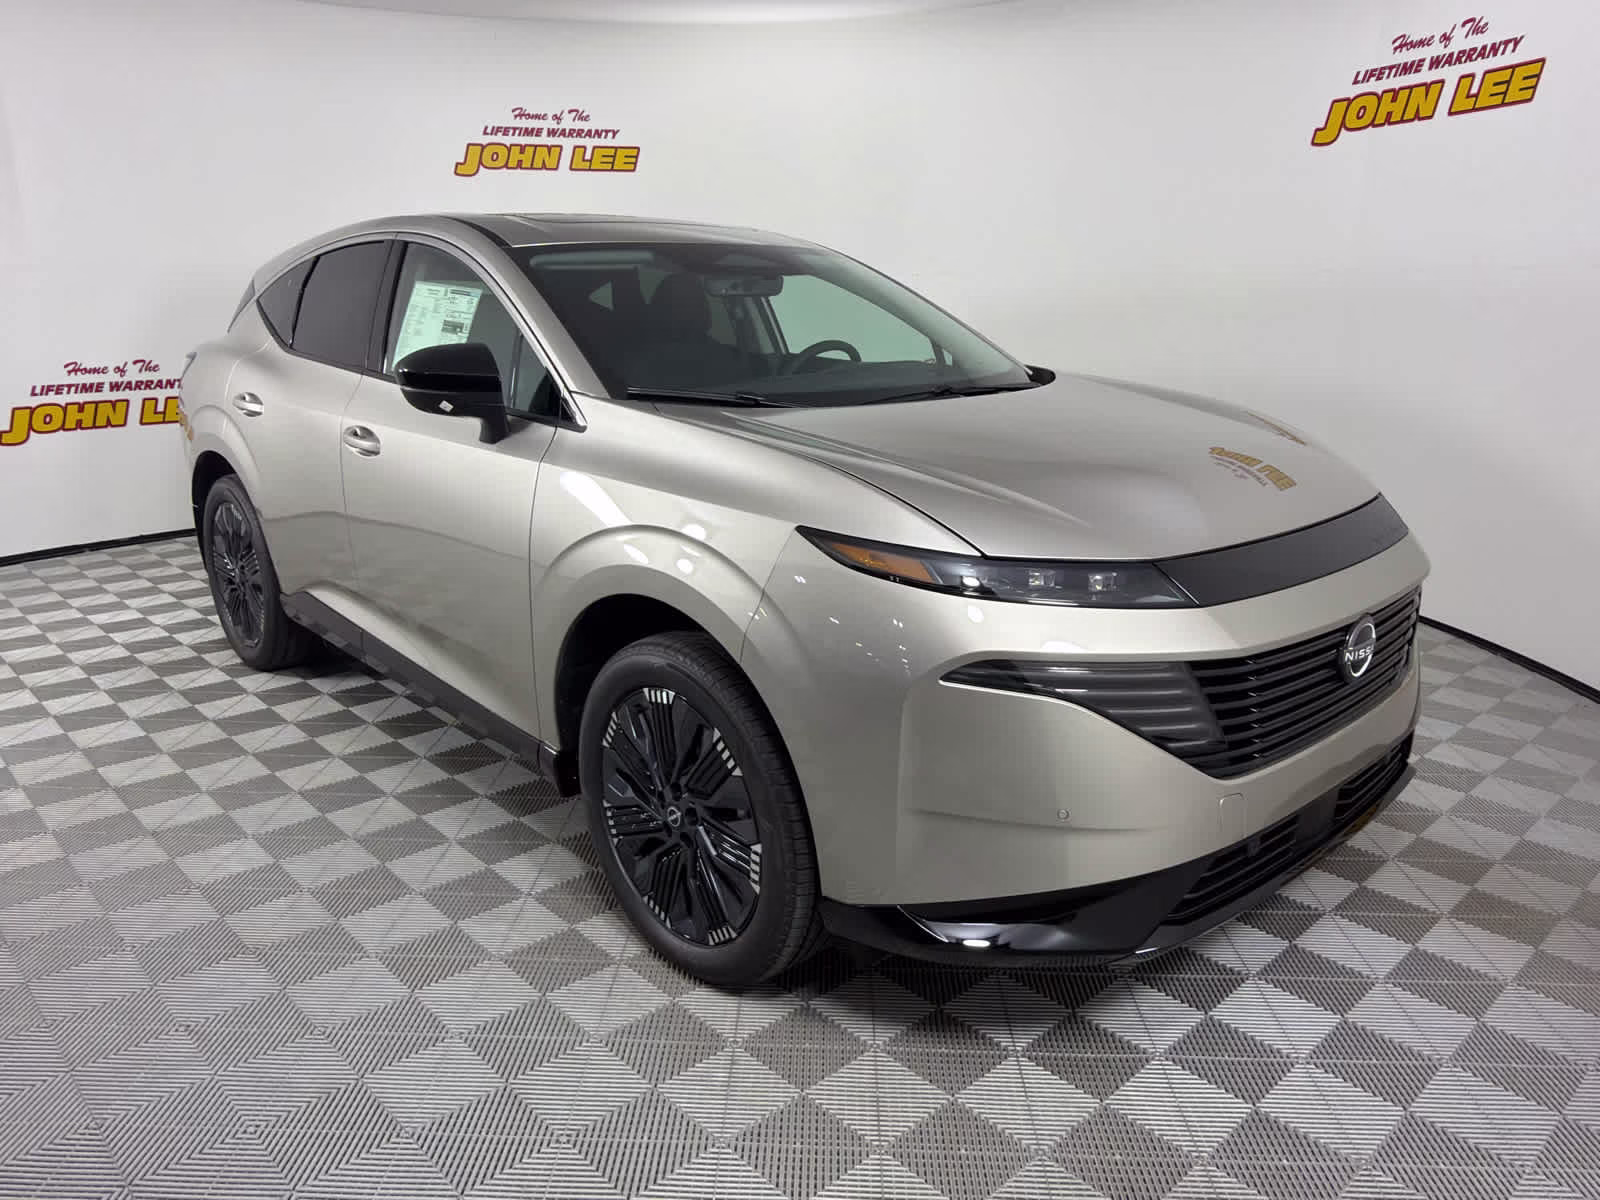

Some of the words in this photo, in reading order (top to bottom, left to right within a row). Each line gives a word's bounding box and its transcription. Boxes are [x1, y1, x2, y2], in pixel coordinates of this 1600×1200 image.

[1391, 33, 1435, 55] Home
[1438, 24, 1456, 49] of
[1461, 16, 1489, 39] The
[1352, 58, 1425, 86] LIFETIME
[1428, 35, 1525, 72] WARRANTY
[1310, 79, 1446, 147] JOHN
[1447, 57, 1547, 117] LEE
[511, 107, 548, 122] Home
[551, 110, 565, 125] of
[567, 109, 591, 122] The
[482, 125, 544, 138] LIFETIME
[546, 127, 620, 140] WARRANTY
[454, 142, 563, 177] JOHN
[569, 145, 641, 173] LEE
[63, 361, 109, 376] Home
[113, 361, 129, 378] of
[132, 359, 160, 374] The
[30, 381, 105, 397] LIFETIME
[108, 378, 183, 393] WARRANT
[0, 399, 130, 446] JOHN
[139, 396, 180, 426] LE
[1344, 646, 1373, 662] NISS
